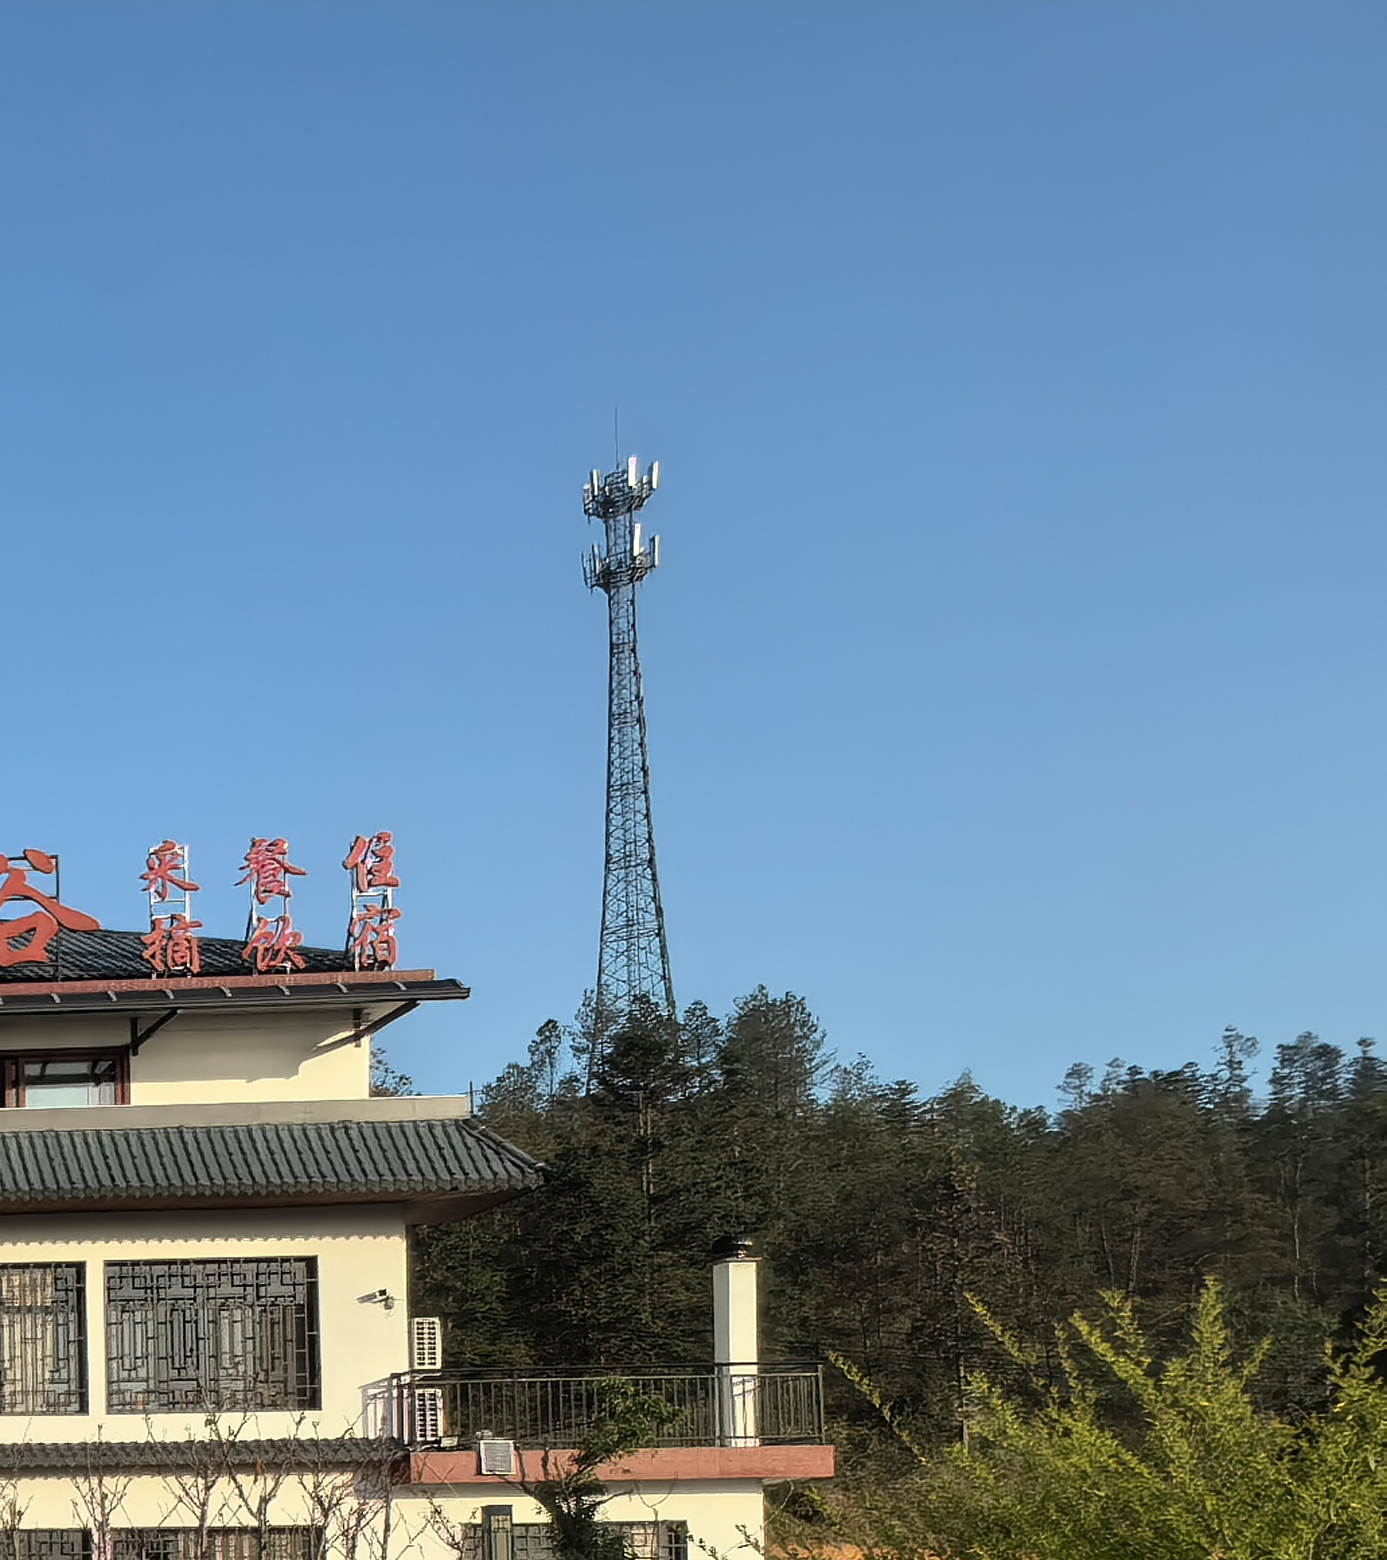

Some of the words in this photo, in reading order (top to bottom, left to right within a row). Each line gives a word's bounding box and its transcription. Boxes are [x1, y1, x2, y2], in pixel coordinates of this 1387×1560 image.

[139, 838, 203, 974] 采摘
[234, 837, 307, 971] 餐饮
[342, 830, 402, 969] 住宿
